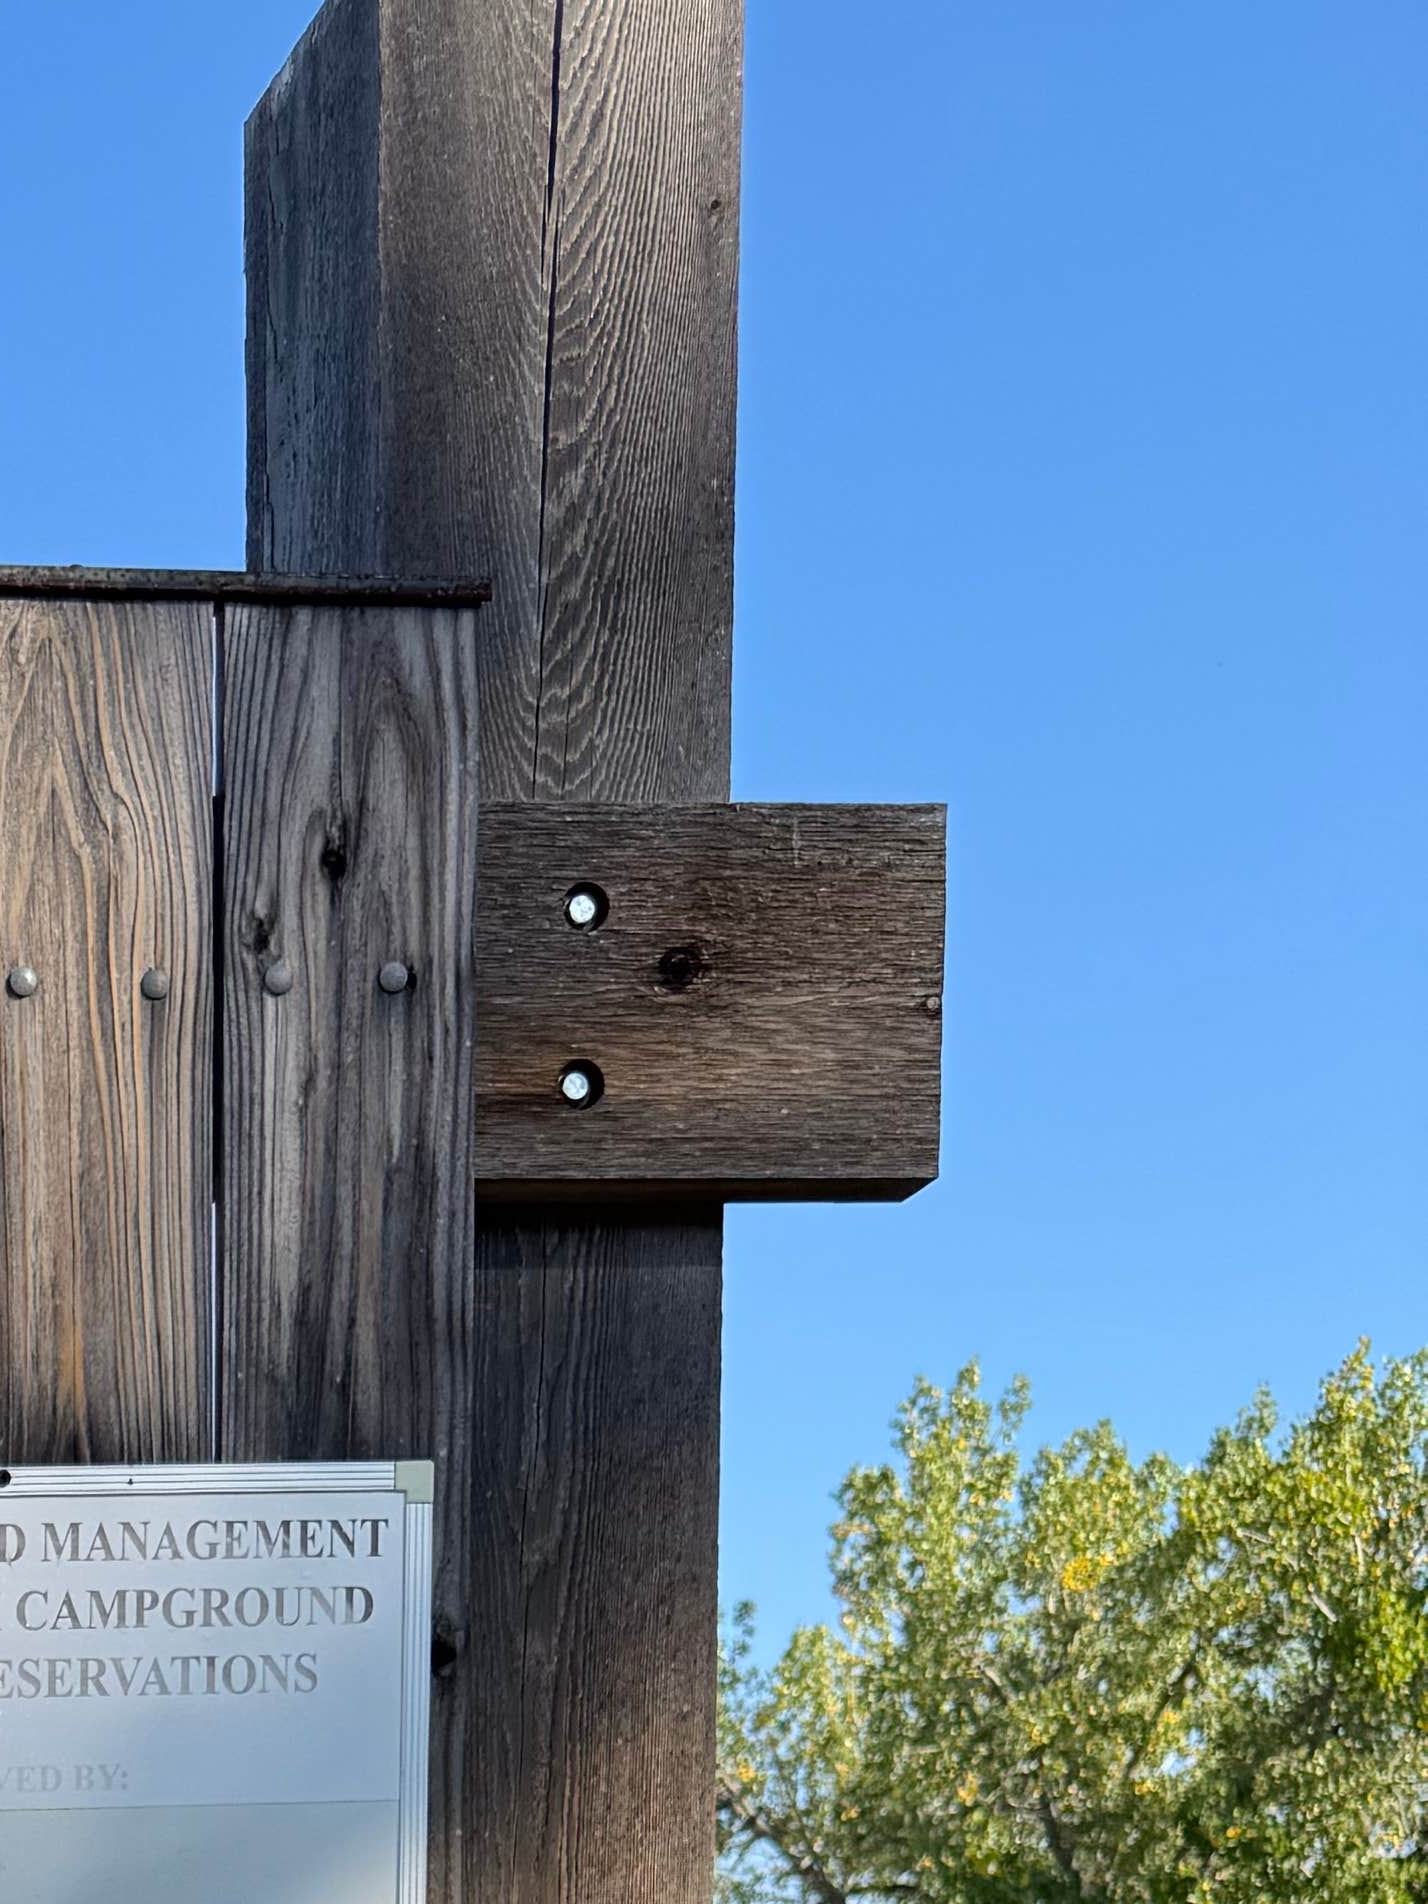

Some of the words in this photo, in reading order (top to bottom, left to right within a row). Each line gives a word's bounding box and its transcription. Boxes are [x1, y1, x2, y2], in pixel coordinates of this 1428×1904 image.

[41, 1518, 389, 1562] MANAGEMENT
[16, 1585, 375, 1631] CAMPGROUND
[74, 1764, 129, 1792] BY:
